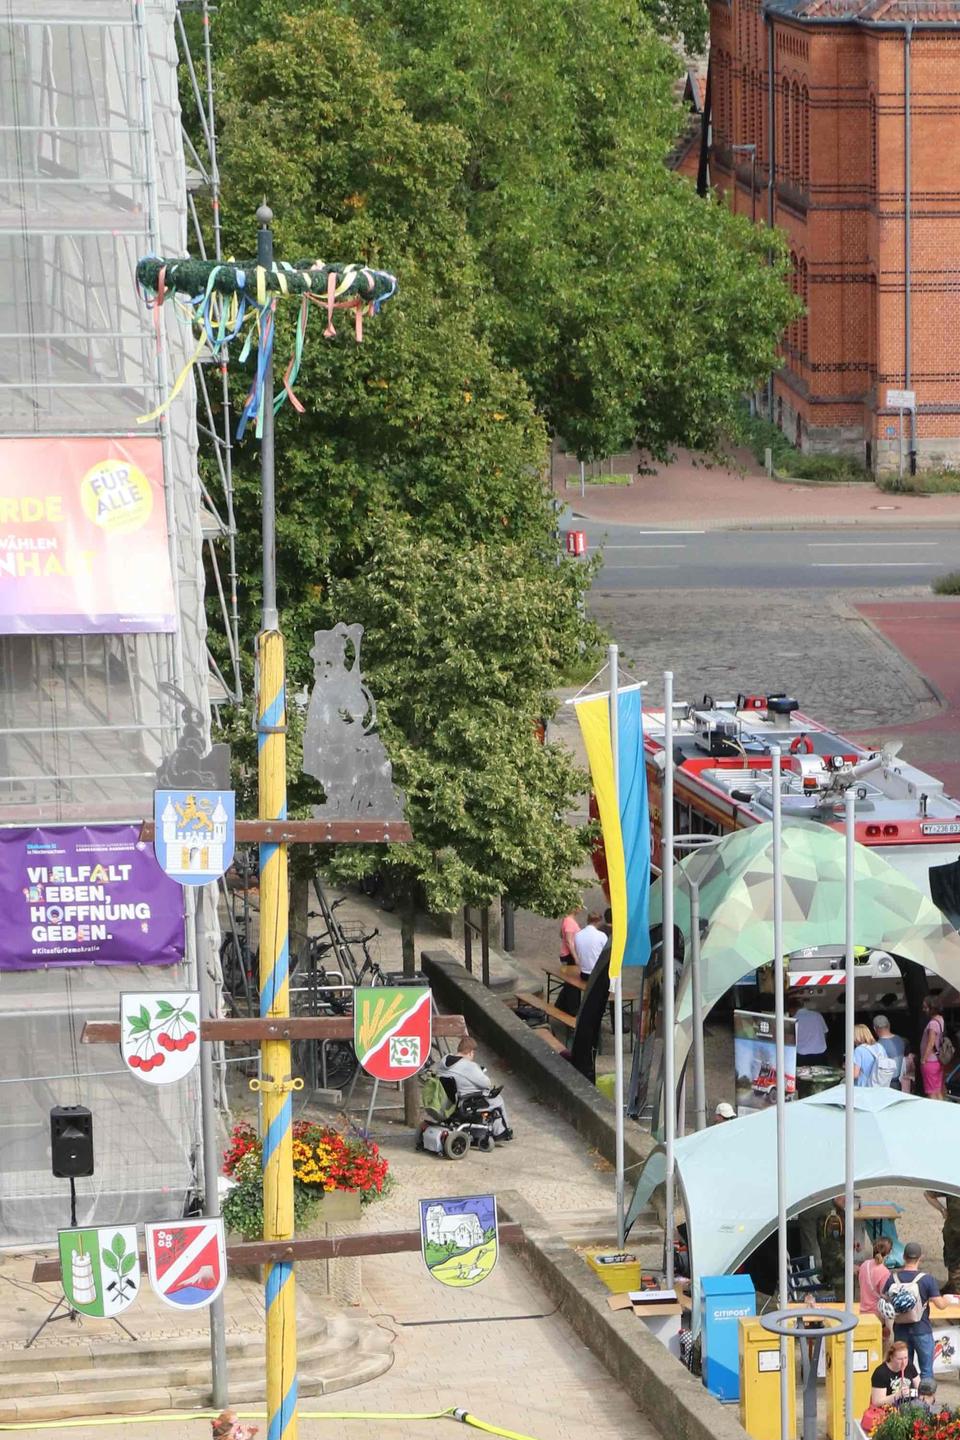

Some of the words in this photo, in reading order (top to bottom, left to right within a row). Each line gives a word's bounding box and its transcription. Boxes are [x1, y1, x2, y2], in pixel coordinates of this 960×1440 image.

[89, 468, 131, 496] FÜR
[97, 485, 143, 516] ALLE
[27, 864, 132, 884] VIELFALT
[30, 903, 150, 922] HOFFNUNG
[32, 924, 112, 942] GEBEN.
[714, 1309, 749, 1317] CITIPOST
